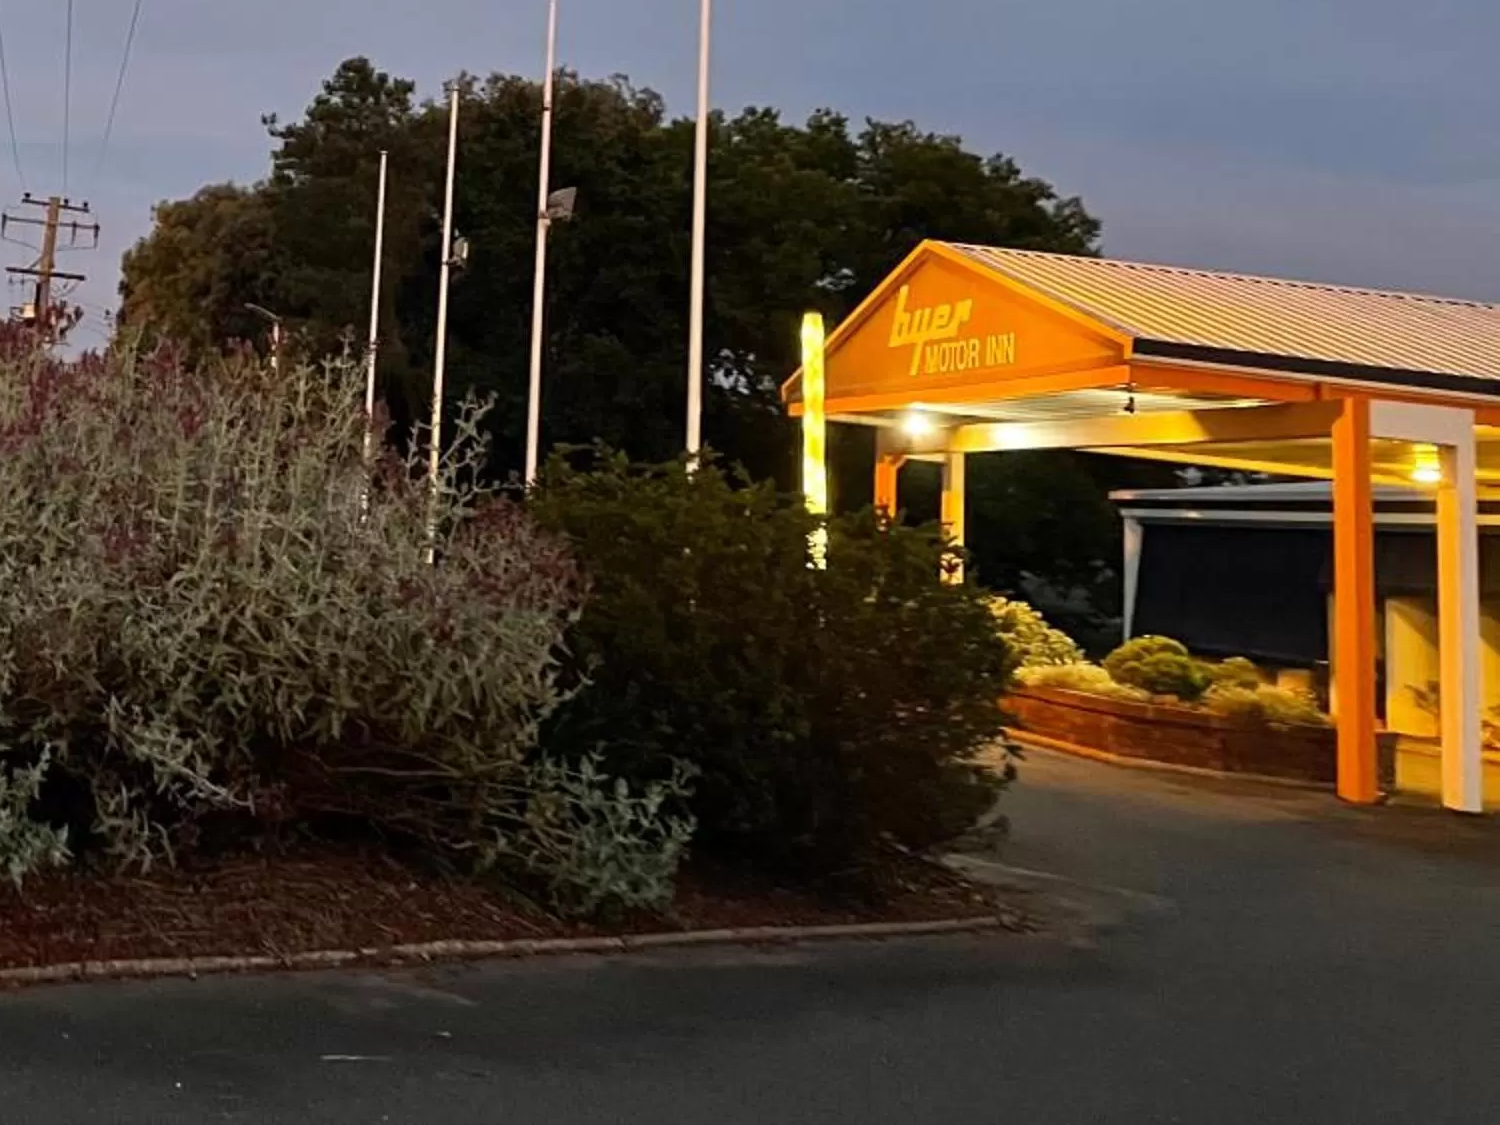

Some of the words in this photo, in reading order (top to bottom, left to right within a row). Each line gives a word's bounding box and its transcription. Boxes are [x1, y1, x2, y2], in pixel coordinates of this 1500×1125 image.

[889, 285, 973, 376] byer
[926, 340, 979, 374] MOTOR
[987, 333, 1015, 364] INN
